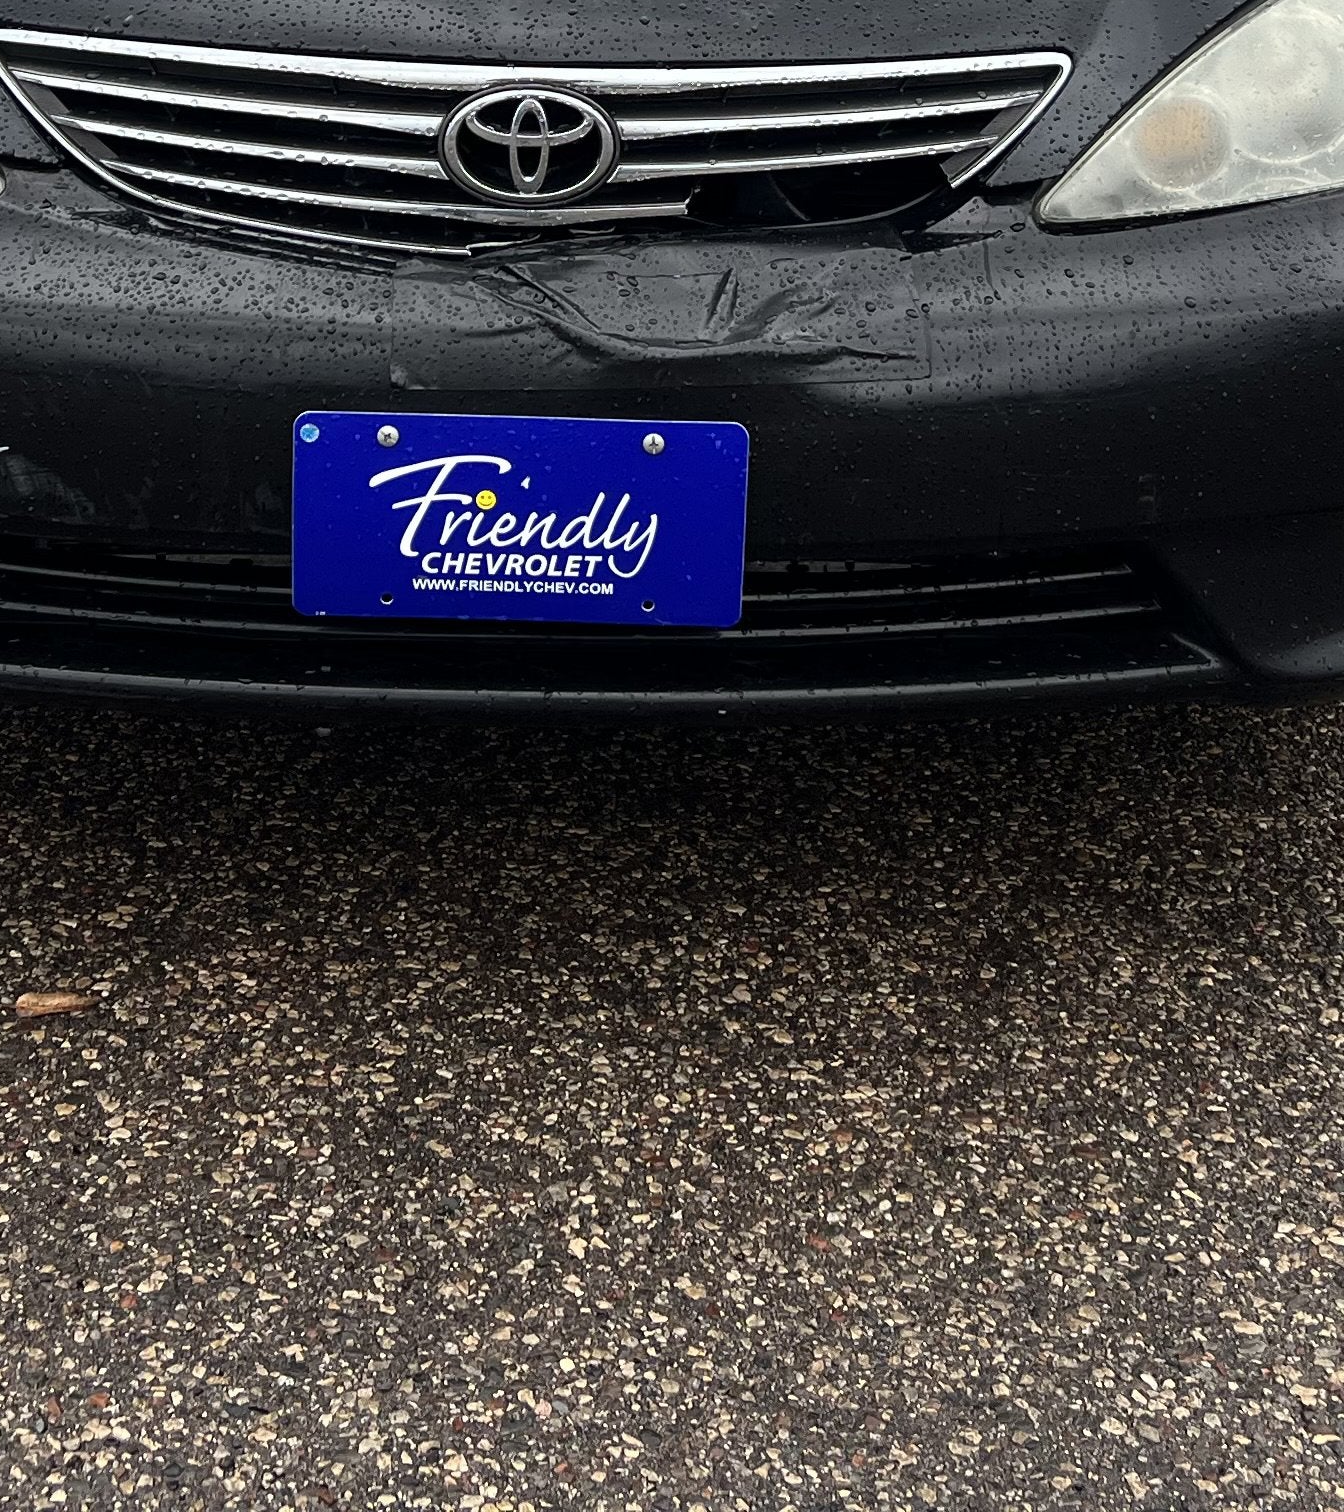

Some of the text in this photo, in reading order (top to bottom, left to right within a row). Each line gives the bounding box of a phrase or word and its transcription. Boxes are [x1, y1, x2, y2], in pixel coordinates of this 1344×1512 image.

[368, 454, 658, 578] Friendly
[421, 551, 603, 577] CHEVROLET
[412, 577, 614, 595] WWW.FRIENDLYCHEV.COM
